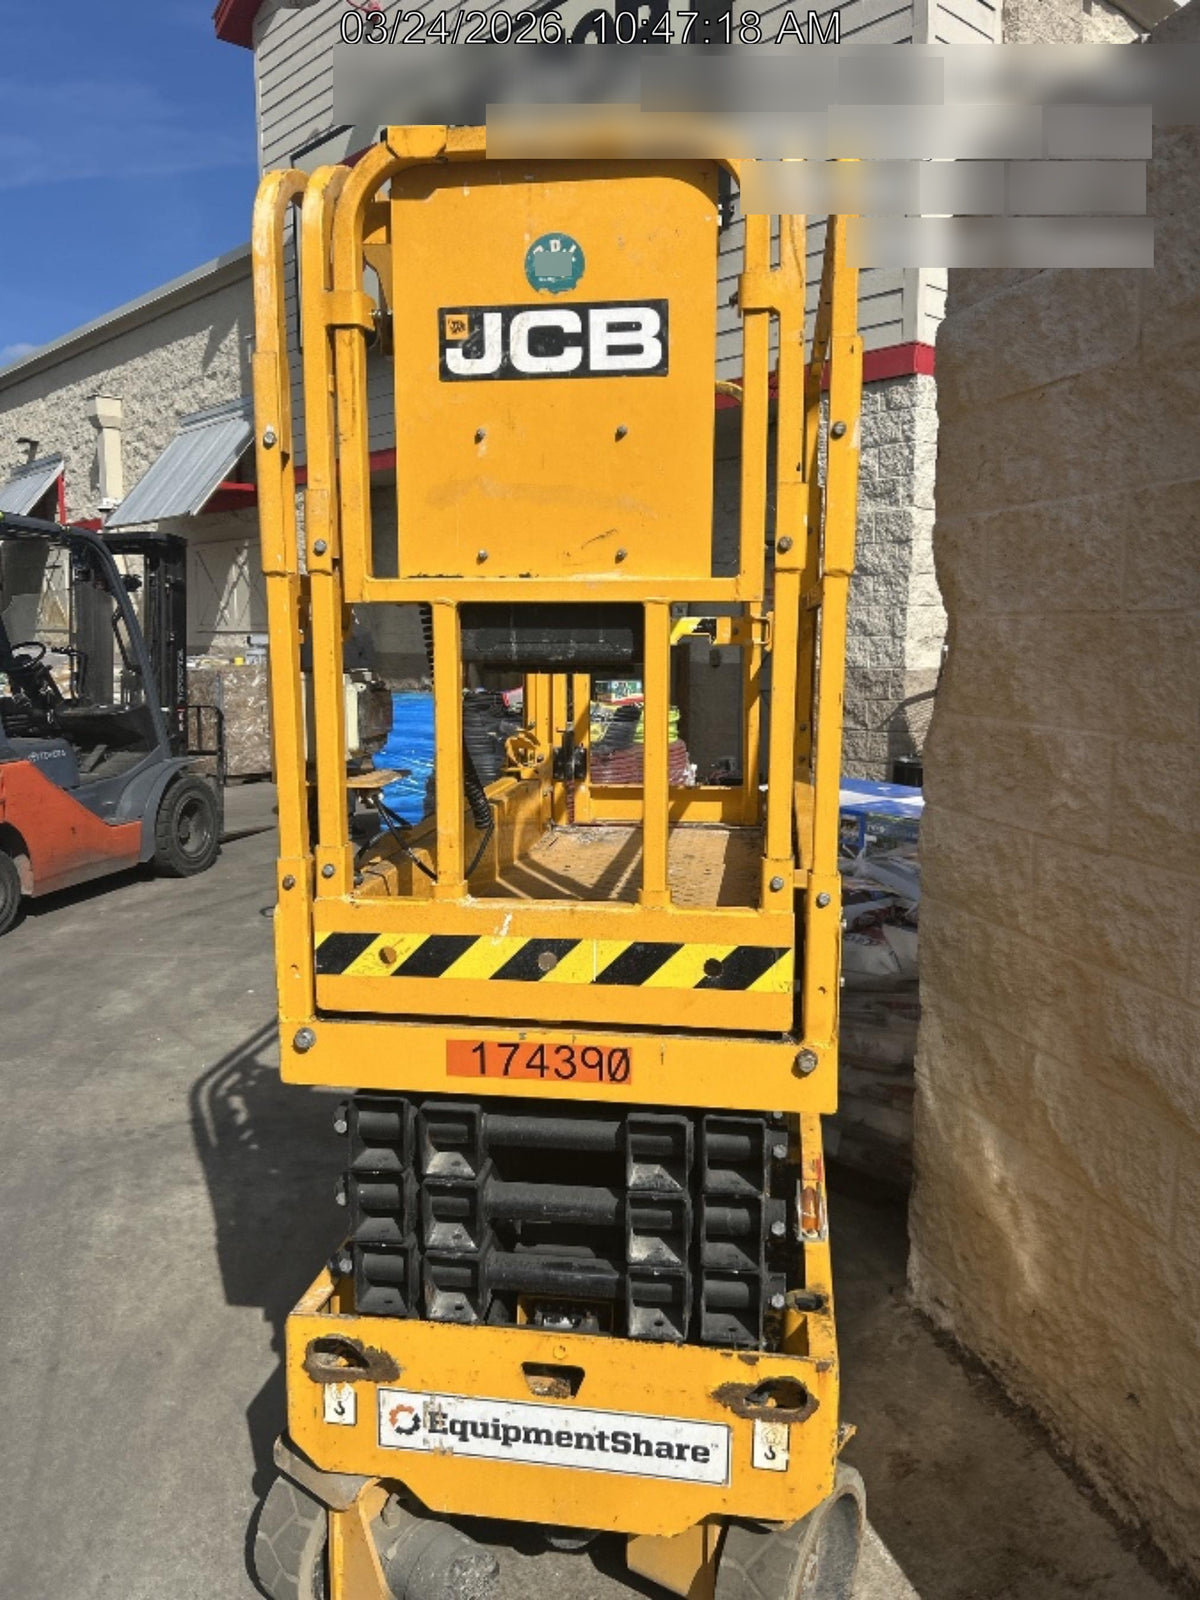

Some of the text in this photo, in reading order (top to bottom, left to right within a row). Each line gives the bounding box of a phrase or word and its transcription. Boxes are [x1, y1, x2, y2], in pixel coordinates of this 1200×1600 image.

[445, 307, 663, 375] JCB
[472, 1041, 631, 1082] 174390
[428, 1410, 710, 1464] EquipmentShare
